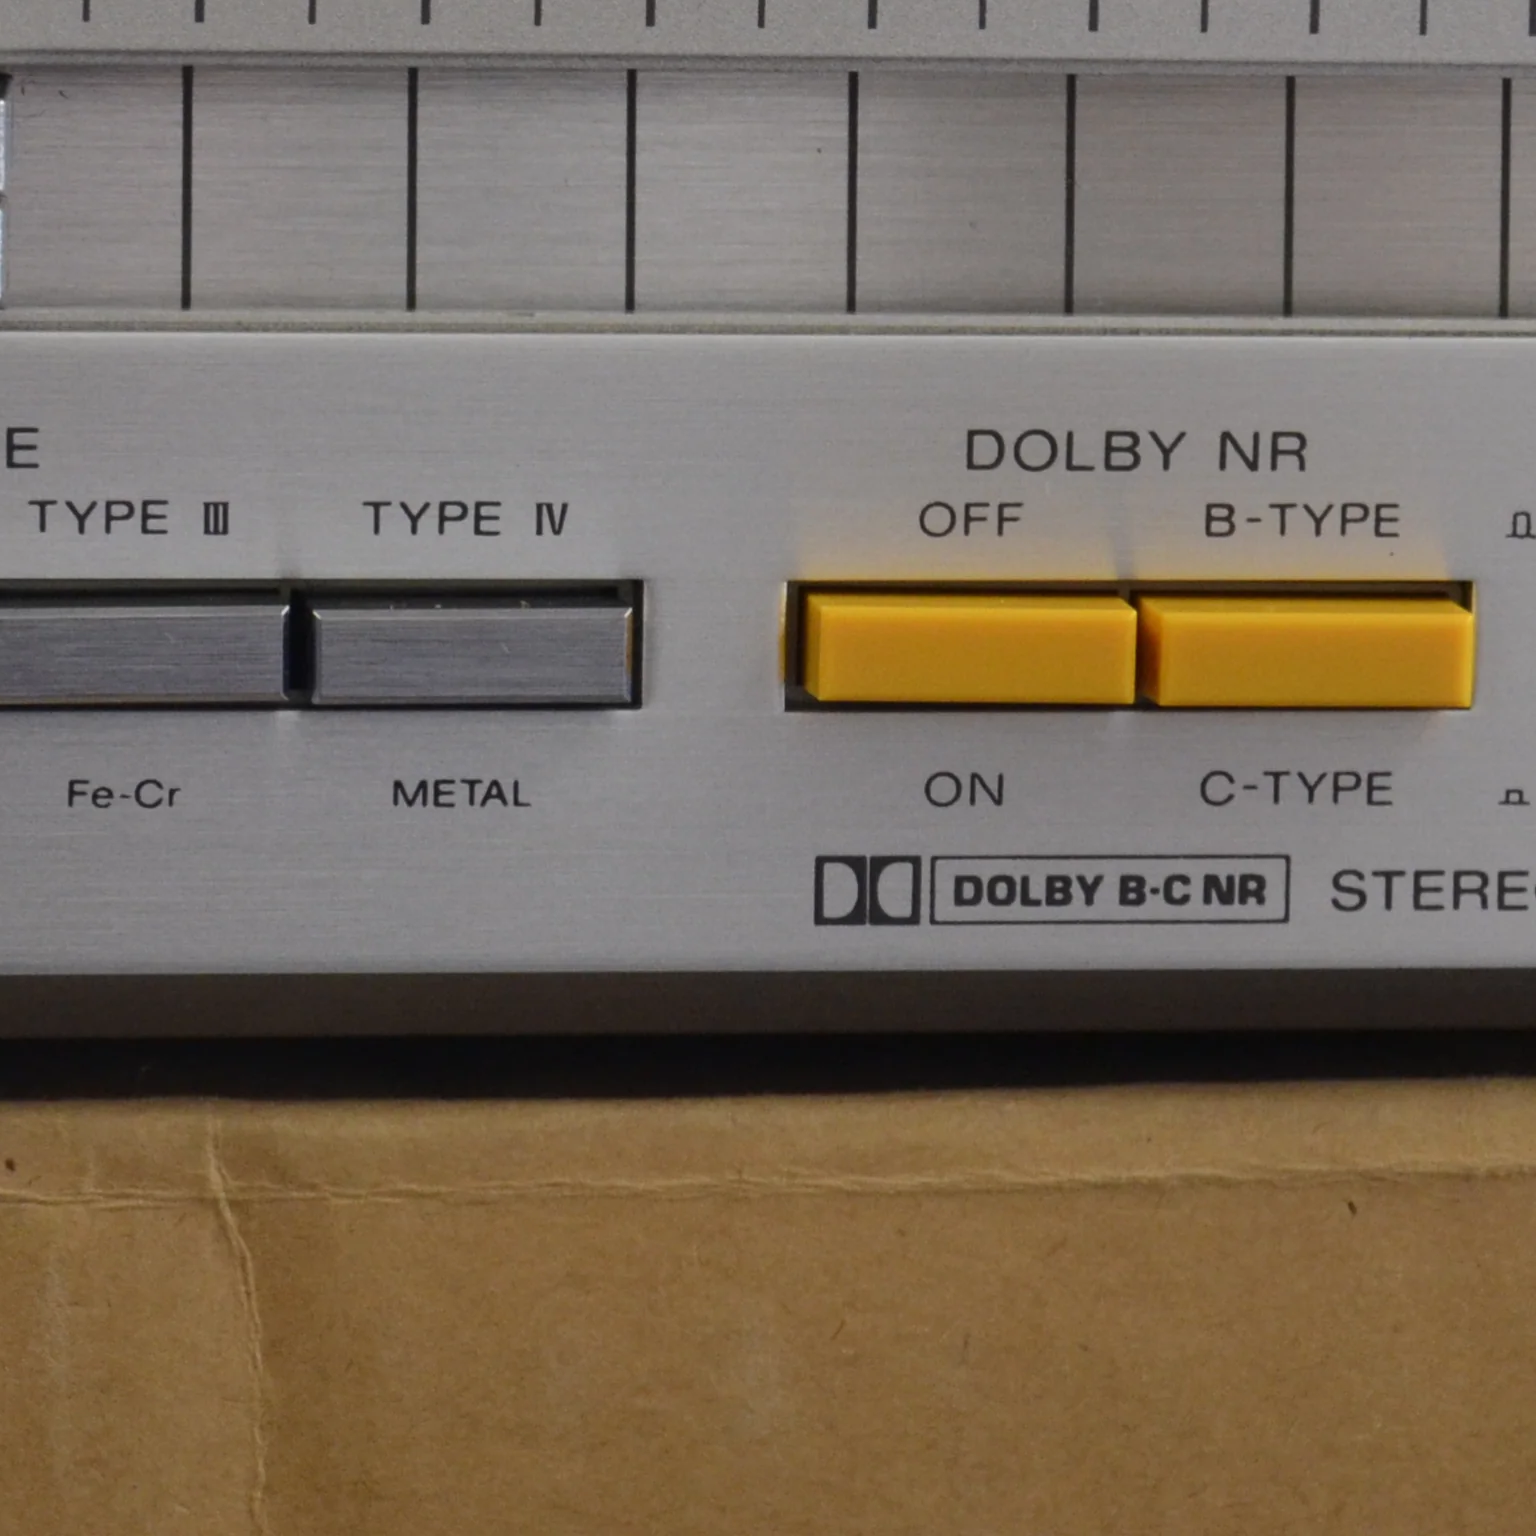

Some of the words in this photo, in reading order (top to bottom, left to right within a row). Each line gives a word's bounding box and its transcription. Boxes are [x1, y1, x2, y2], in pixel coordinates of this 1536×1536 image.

[966, 428, 1187, 473] DOLBY
[1218, 430, 1308, 472] NR
[28, 499, 169, 535] TYPE
[362, 500, 502, 537] TYPE
[918, 500, 1024, 538] OFF
[1204, 502, 1399, 538] B-TYPE
[67, 778, 180, 809] Fe-Cr
[392, 778, 530, 809] METAL
[923, 770, 1005, 808] ON
[1199, 769, 1392, 807] C-TYPE
[953, 874, 1104, 907] DOLBY
[1202, 873, 1267, 906] NR
